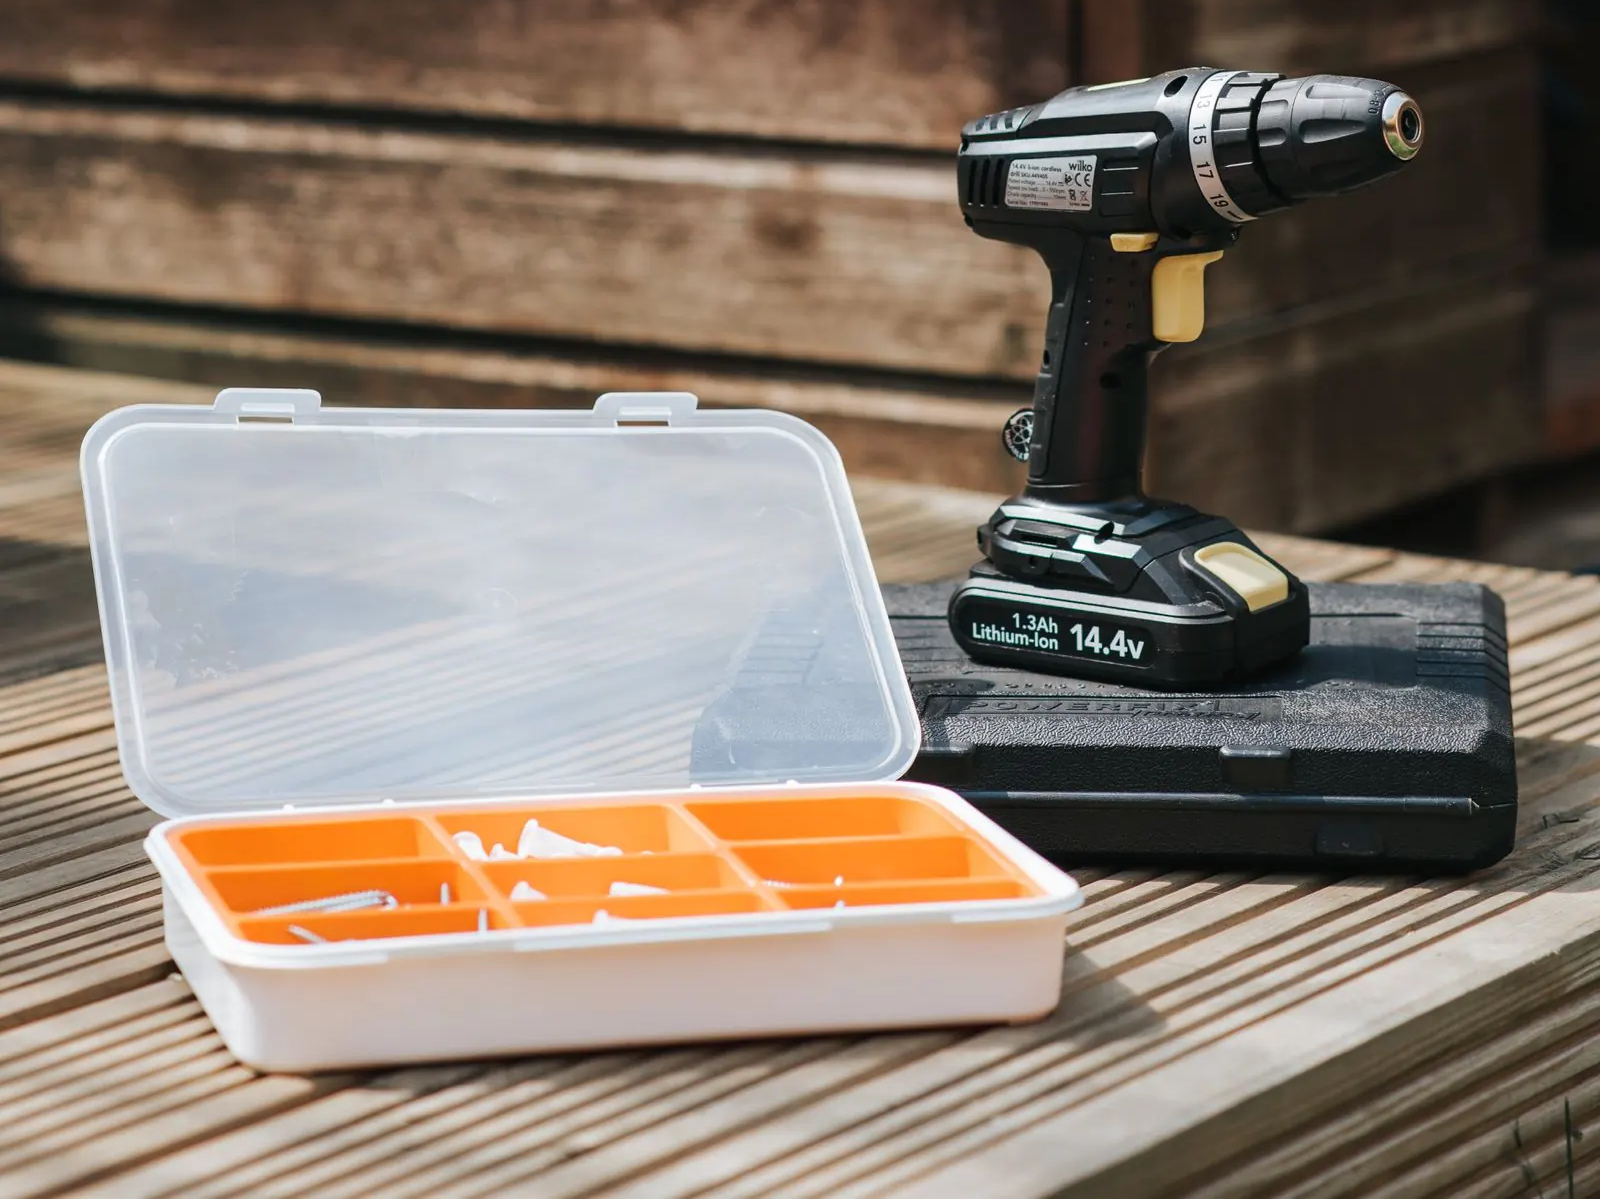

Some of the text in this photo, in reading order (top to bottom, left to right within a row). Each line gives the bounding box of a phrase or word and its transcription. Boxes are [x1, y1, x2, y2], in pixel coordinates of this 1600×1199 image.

[1197, 93, 1212, 109] 13
[1193, 123, 1207, 145] 15
[1068, 160, 1093, 172] wilko
[1196, 161, 1214, 179] 17
[1209, 193, 1229, 208] 19
[1012, 613, 1058, 634] 1.3Ah
[972, 622, 1059, 650] Lithium-Ion
[1069, 624, 1145, 660] 14.4v
